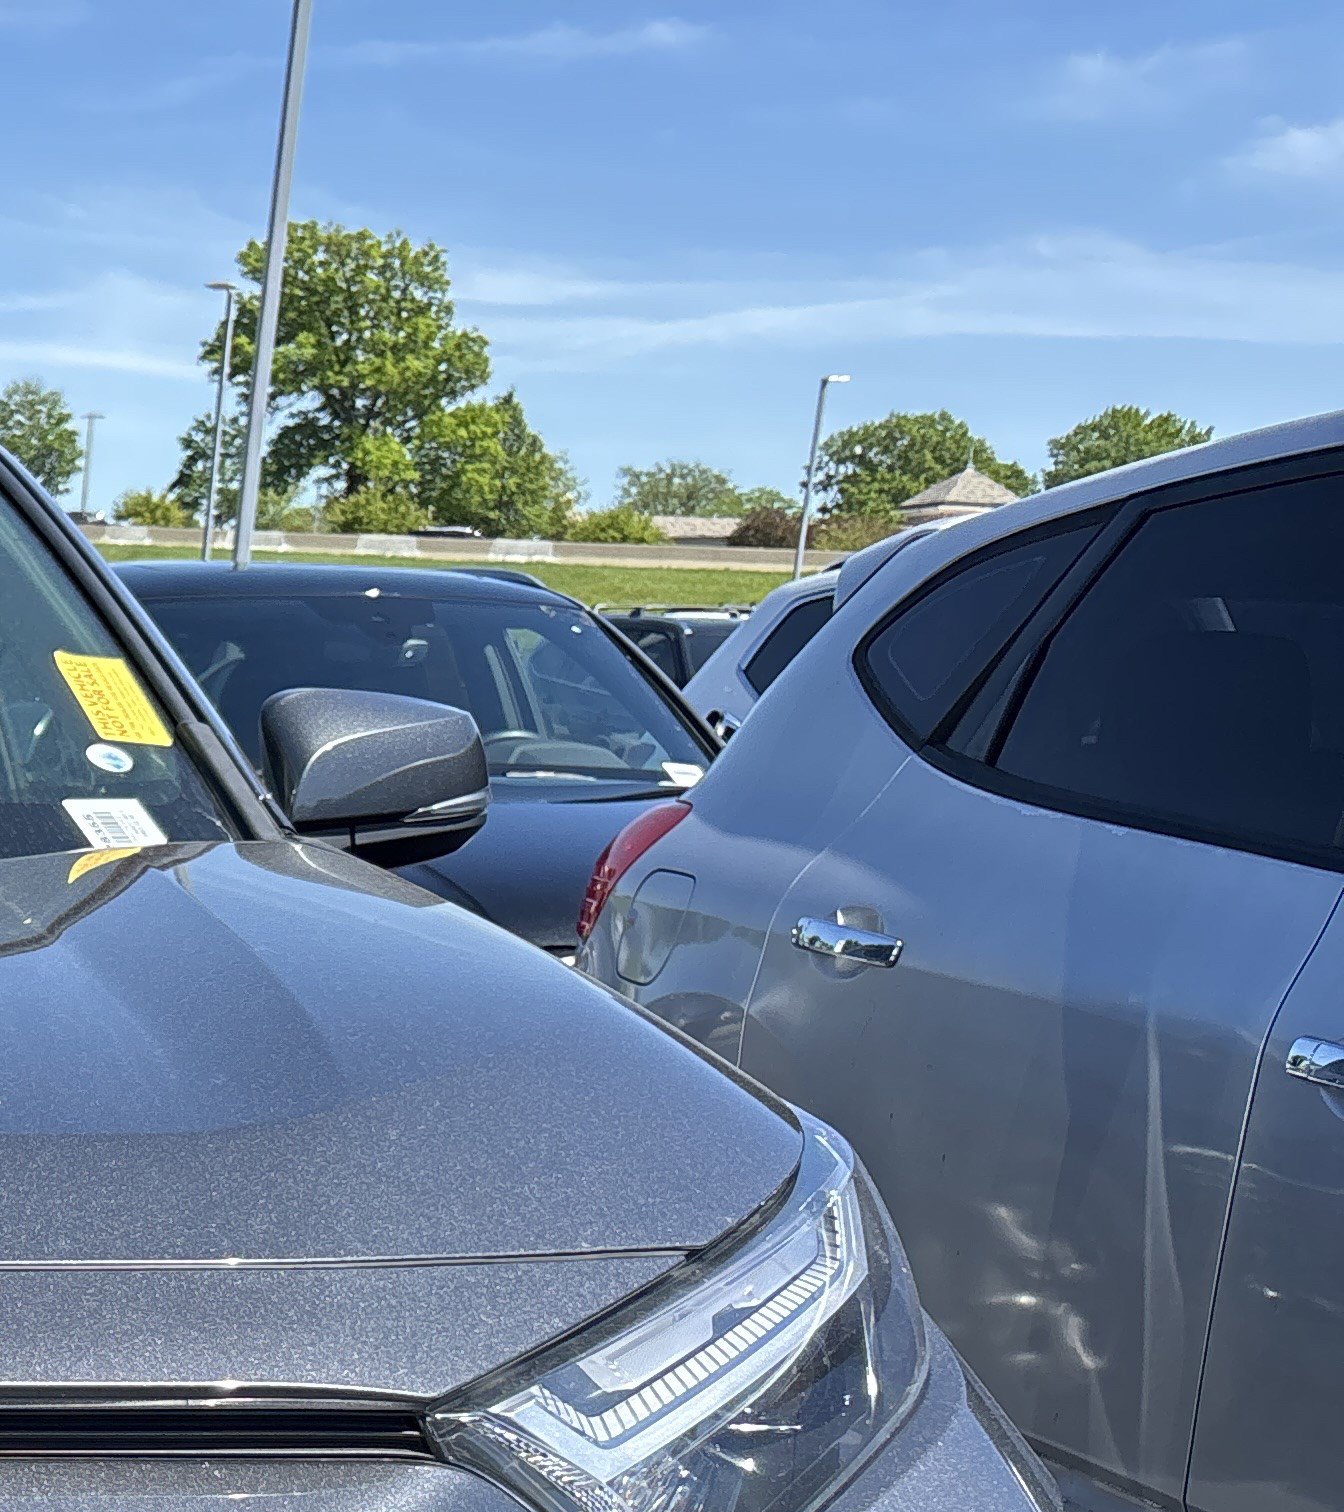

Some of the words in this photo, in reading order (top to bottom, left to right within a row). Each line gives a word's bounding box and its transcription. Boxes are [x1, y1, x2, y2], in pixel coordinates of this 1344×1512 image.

[61, 660, 98, 707] VEHICLE
[75, 661, 100, 686] SALE
[93, 689, 115, 711] FOR
[91, 709, 116, 736] THIS
[105, 713, 130, 738] NOT
